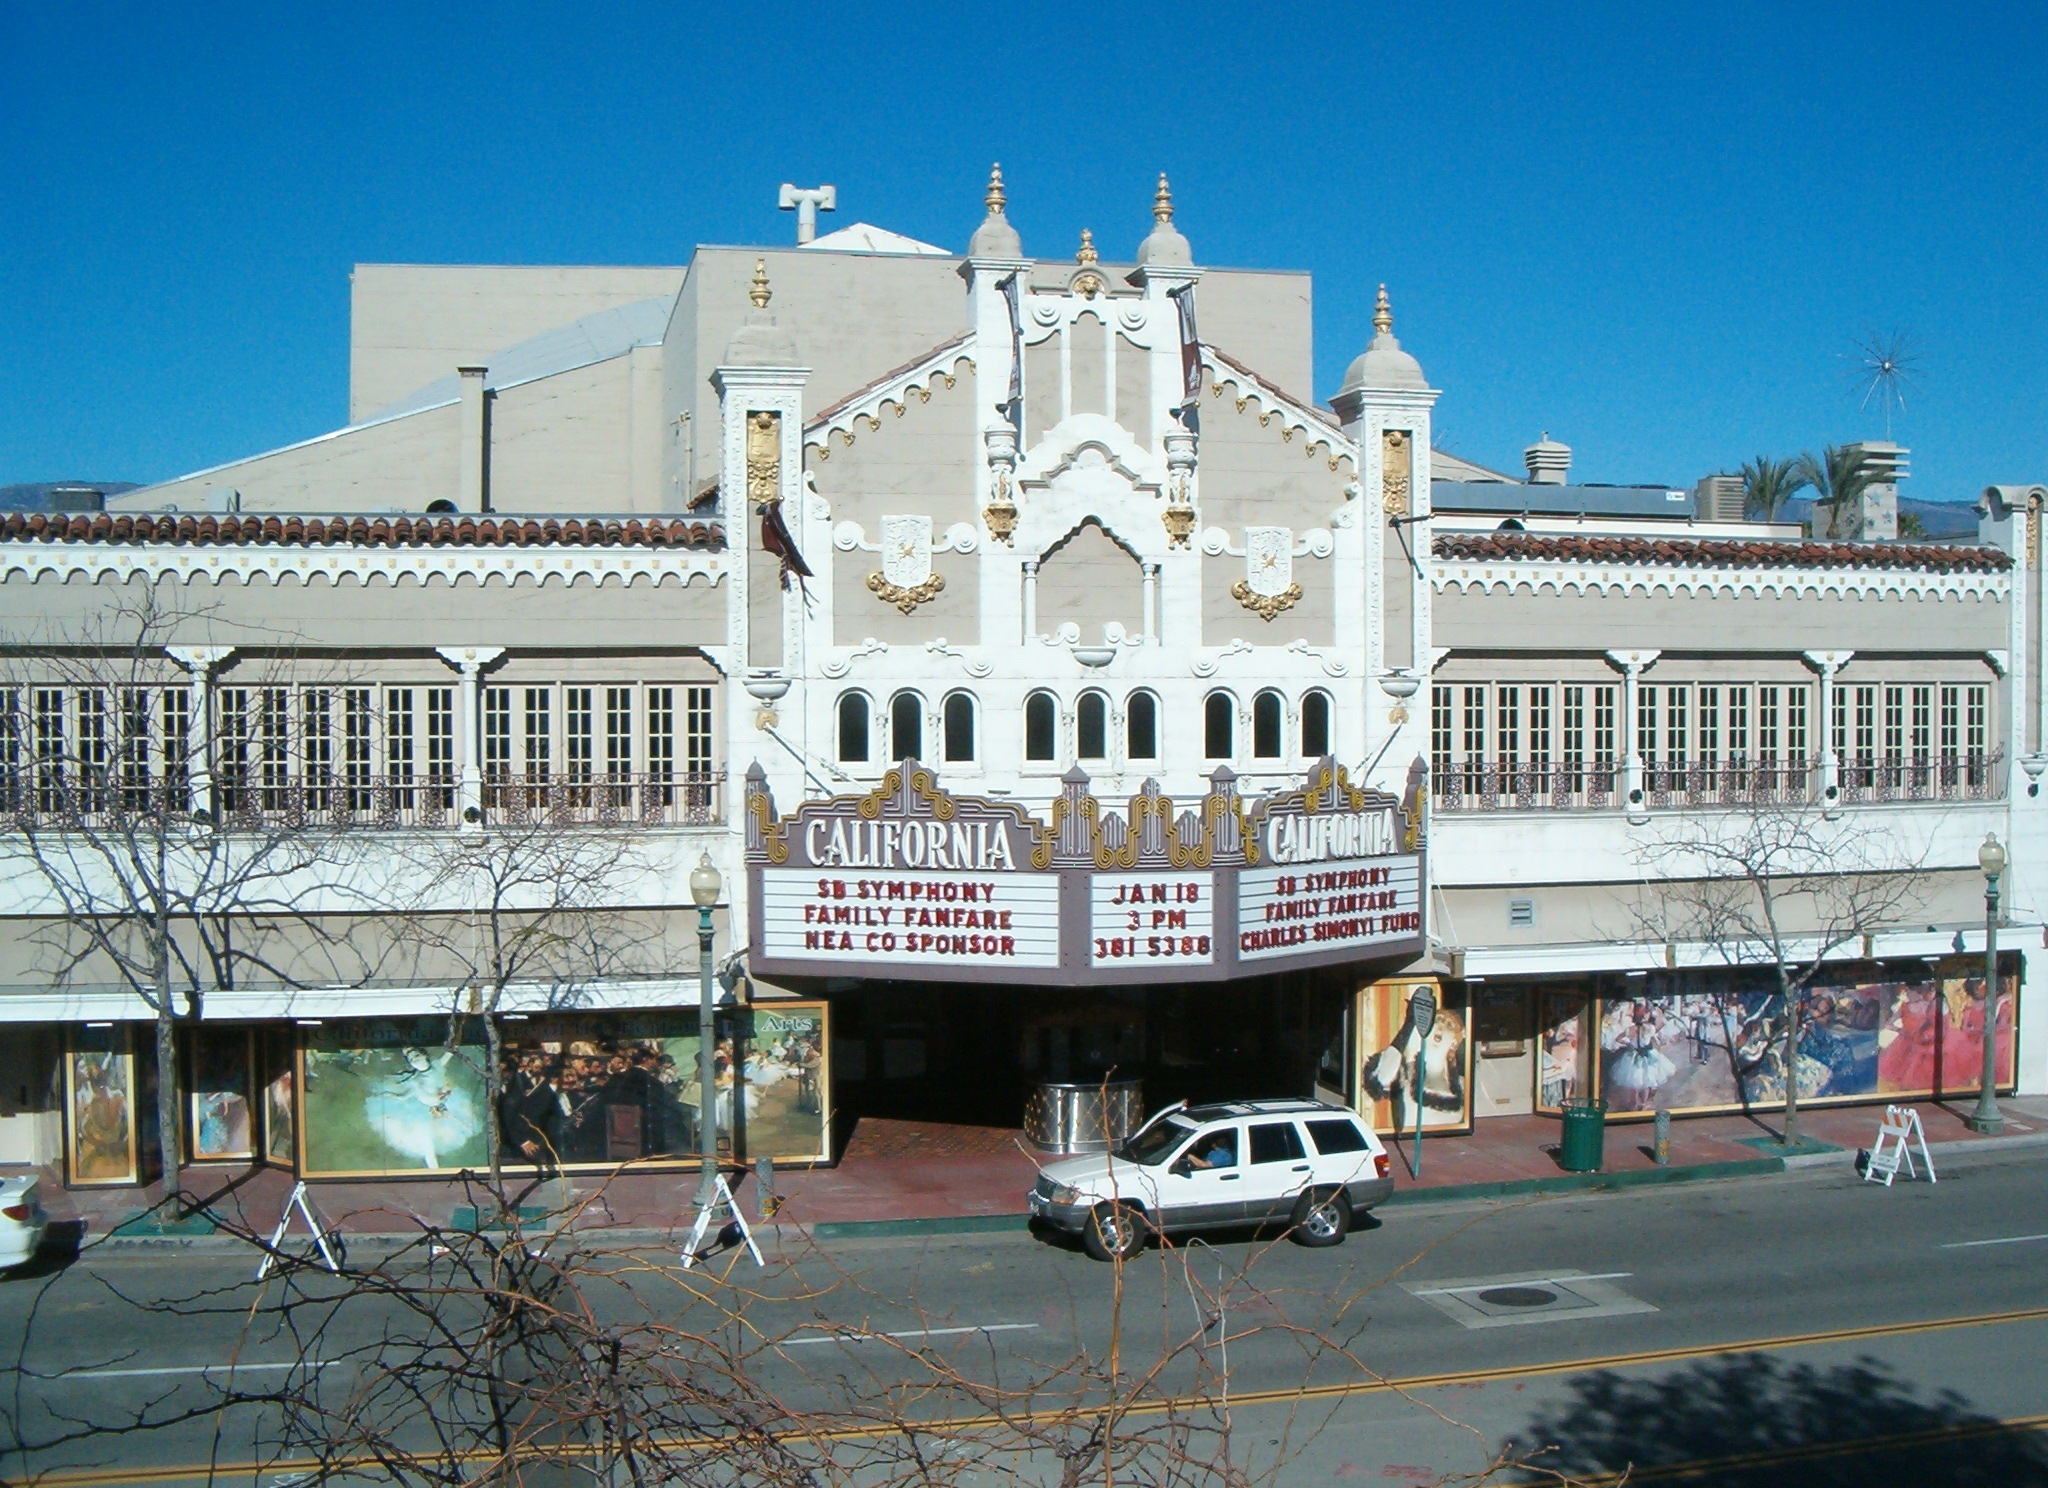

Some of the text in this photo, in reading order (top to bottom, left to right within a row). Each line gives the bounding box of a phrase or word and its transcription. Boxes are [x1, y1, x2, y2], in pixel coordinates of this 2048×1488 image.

[804, 817, 1017, 871] CALIFORNIA
[1268, 807, 1399, 865] CALIFORNIA
[817, 878, 995, 903] SB SYMPHONY
[1111, 883, 1199, 906] JAN 18
[1276, 867, 1392, 896] SB SYMPHONY
[804, 904, 1013, 930] FAMILY FANFARE
[1265, 889, 1398, 923] FAMILY FANFARE
[1126, 909, 1186, 931] 3 PM
[1240, 911, 1420, 953] CHARLES SIMONYI FUND
[804, 930, 1015, 956] NEA CO SPONSOR
[1094, 935, 1210, 958] 381 5388
[761, 1016, 813, 1032] Arts
